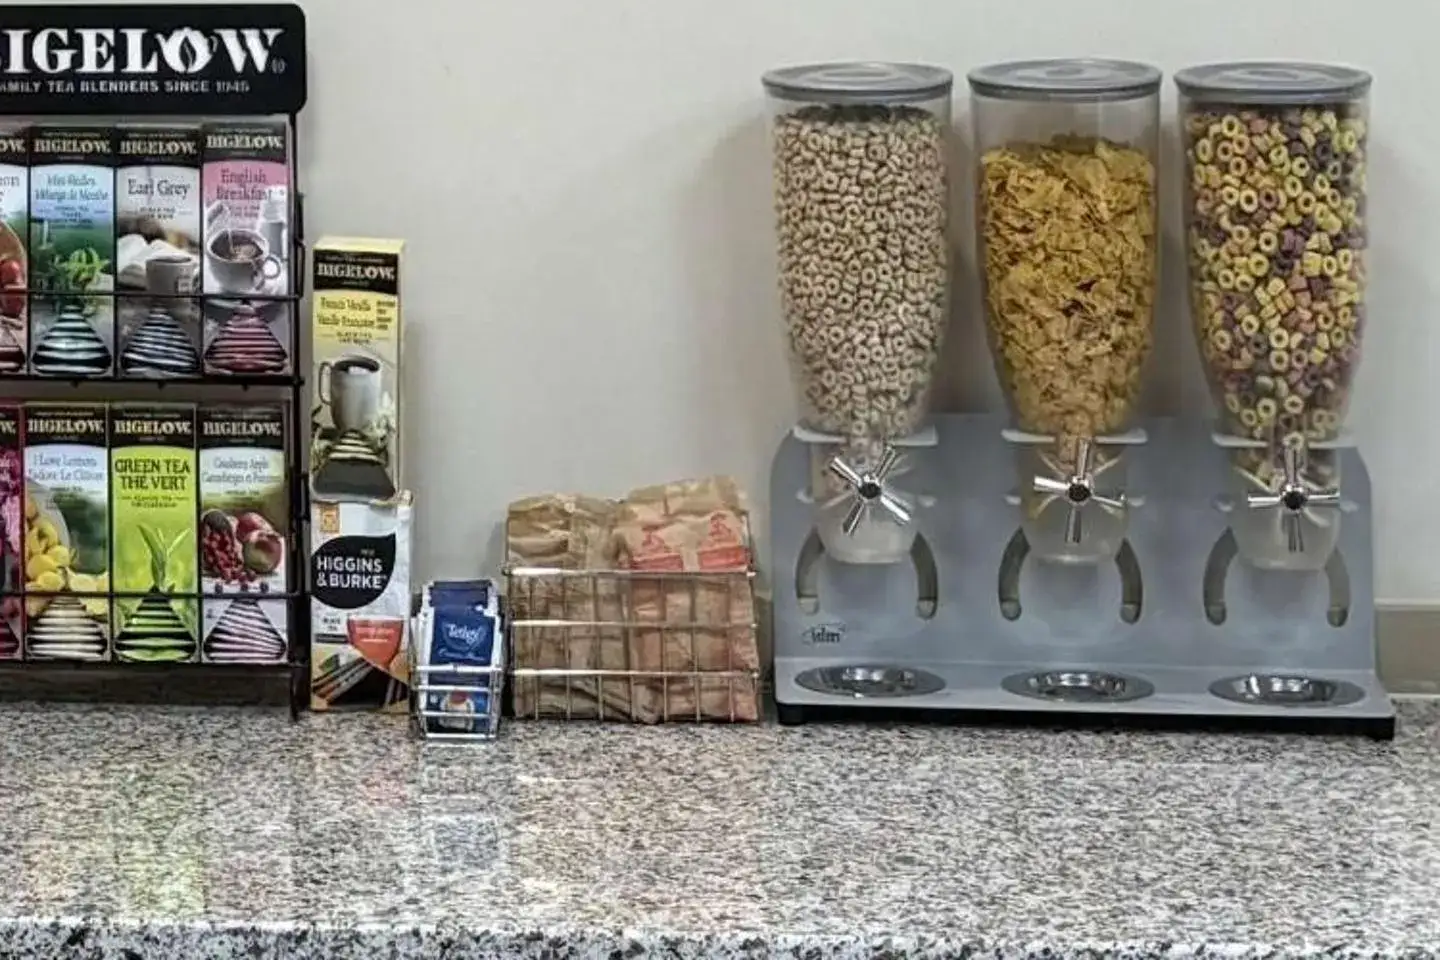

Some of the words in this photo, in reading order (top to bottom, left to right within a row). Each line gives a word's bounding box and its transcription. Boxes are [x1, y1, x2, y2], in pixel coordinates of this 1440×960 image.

[46, 80, 75, 93] TEA
[79, 80, 159, 93] BLENDERS
[163, 80, 210, 93] SINCE
[220, 167, 267, 188] English
[127, 178, 154, 195] Earl
[157, 178, 191, 201] Grey
[215, 183, 273, 201] Breakfast
[114, 457, 161, 474] GREEN
[164, 458, 191, 474] TEA
[150, 475, 187, 491] VERT
[316, 555, 383, 574] HIGGINS
[447, 622, 482, 646] Tetley
